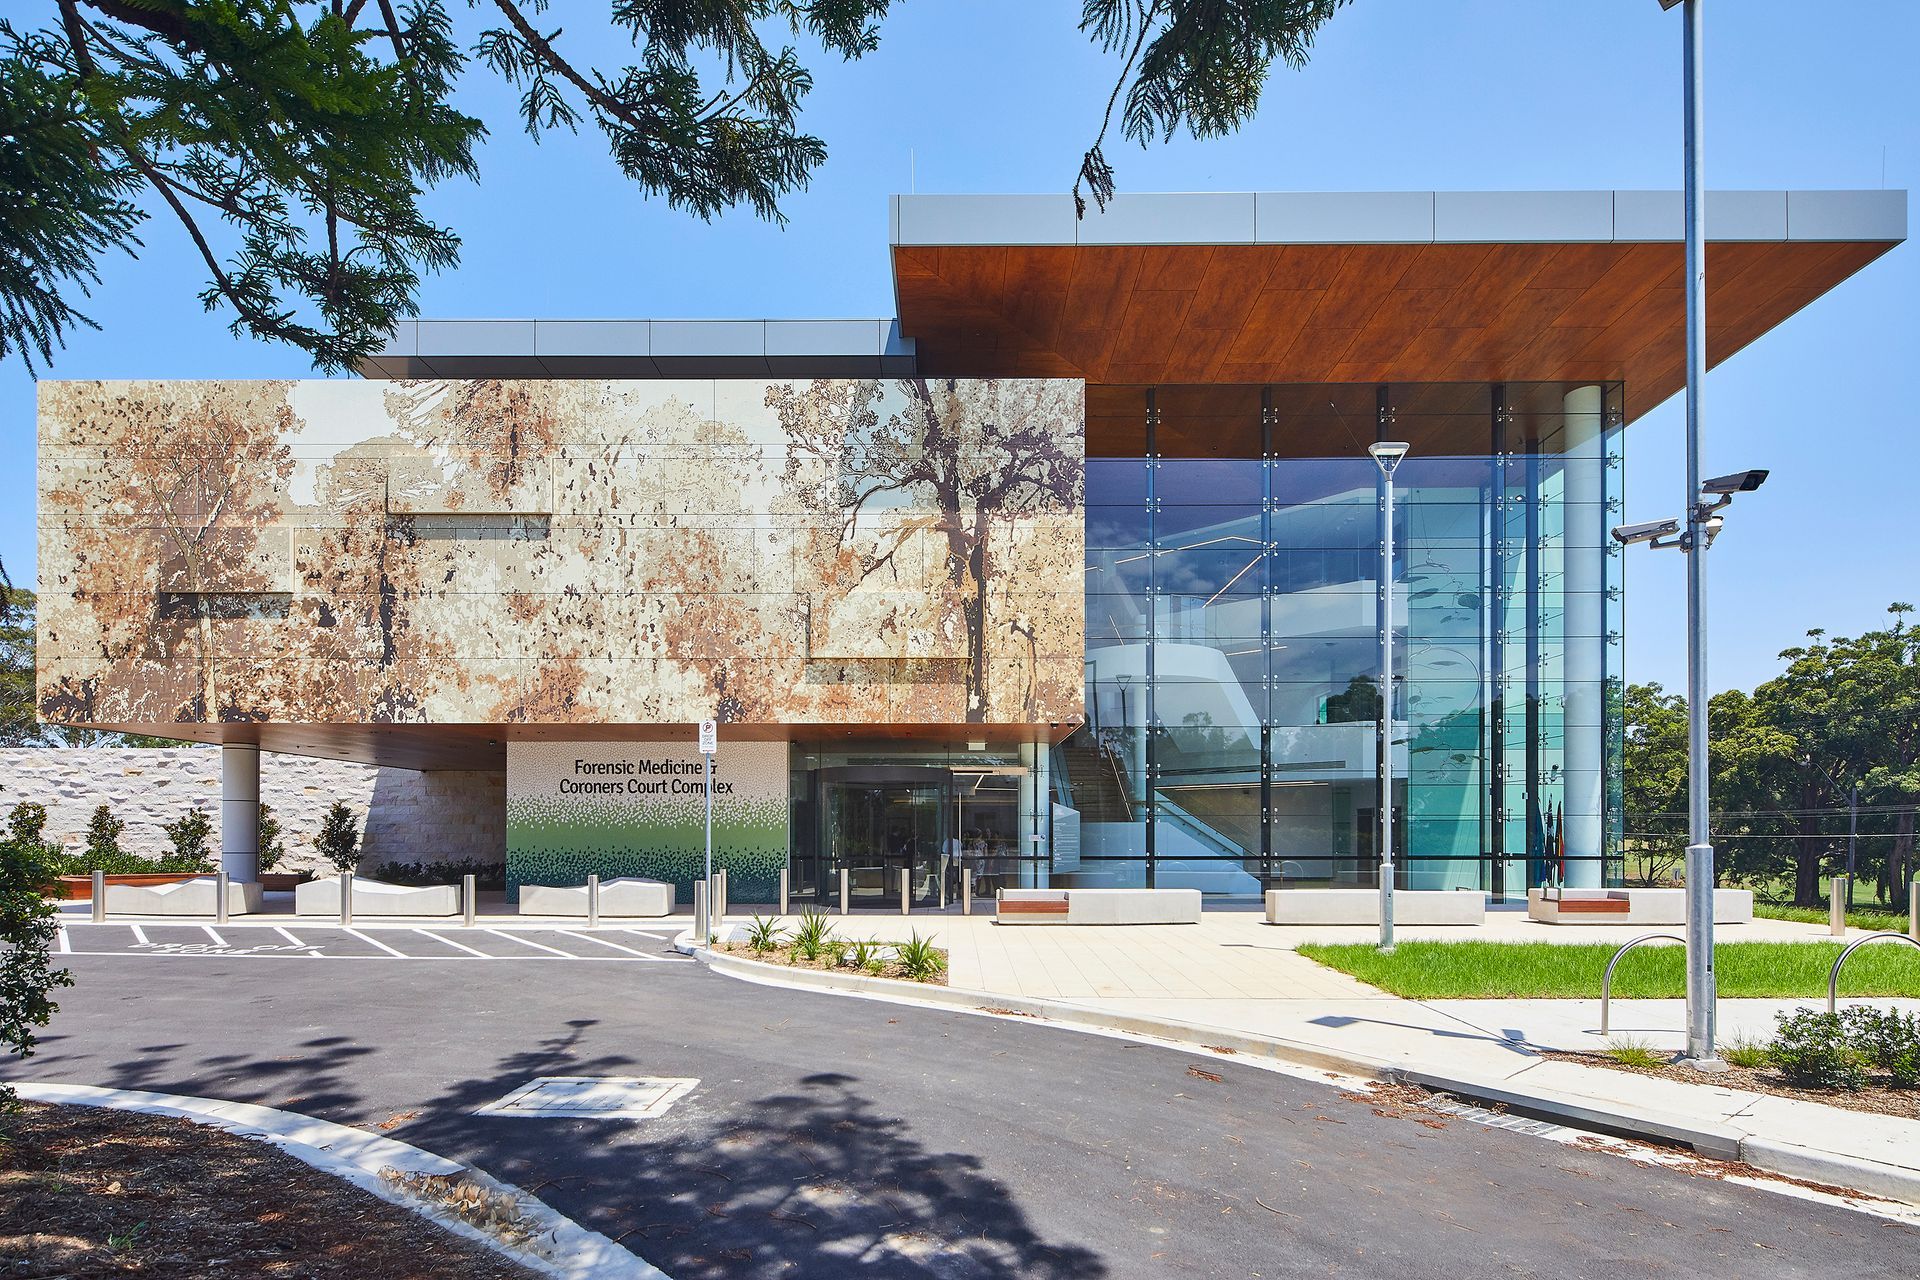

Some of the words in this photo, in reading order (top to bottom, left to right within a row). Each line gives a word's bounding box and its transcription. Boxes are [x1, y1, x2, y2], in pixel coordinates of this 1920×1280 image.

[575, 759, 634, 774] Forensic
[639, 759, 702, 774] Medicine
[560, 779, 623, 793] Coroners
[628, 779, 667, 793] Court
